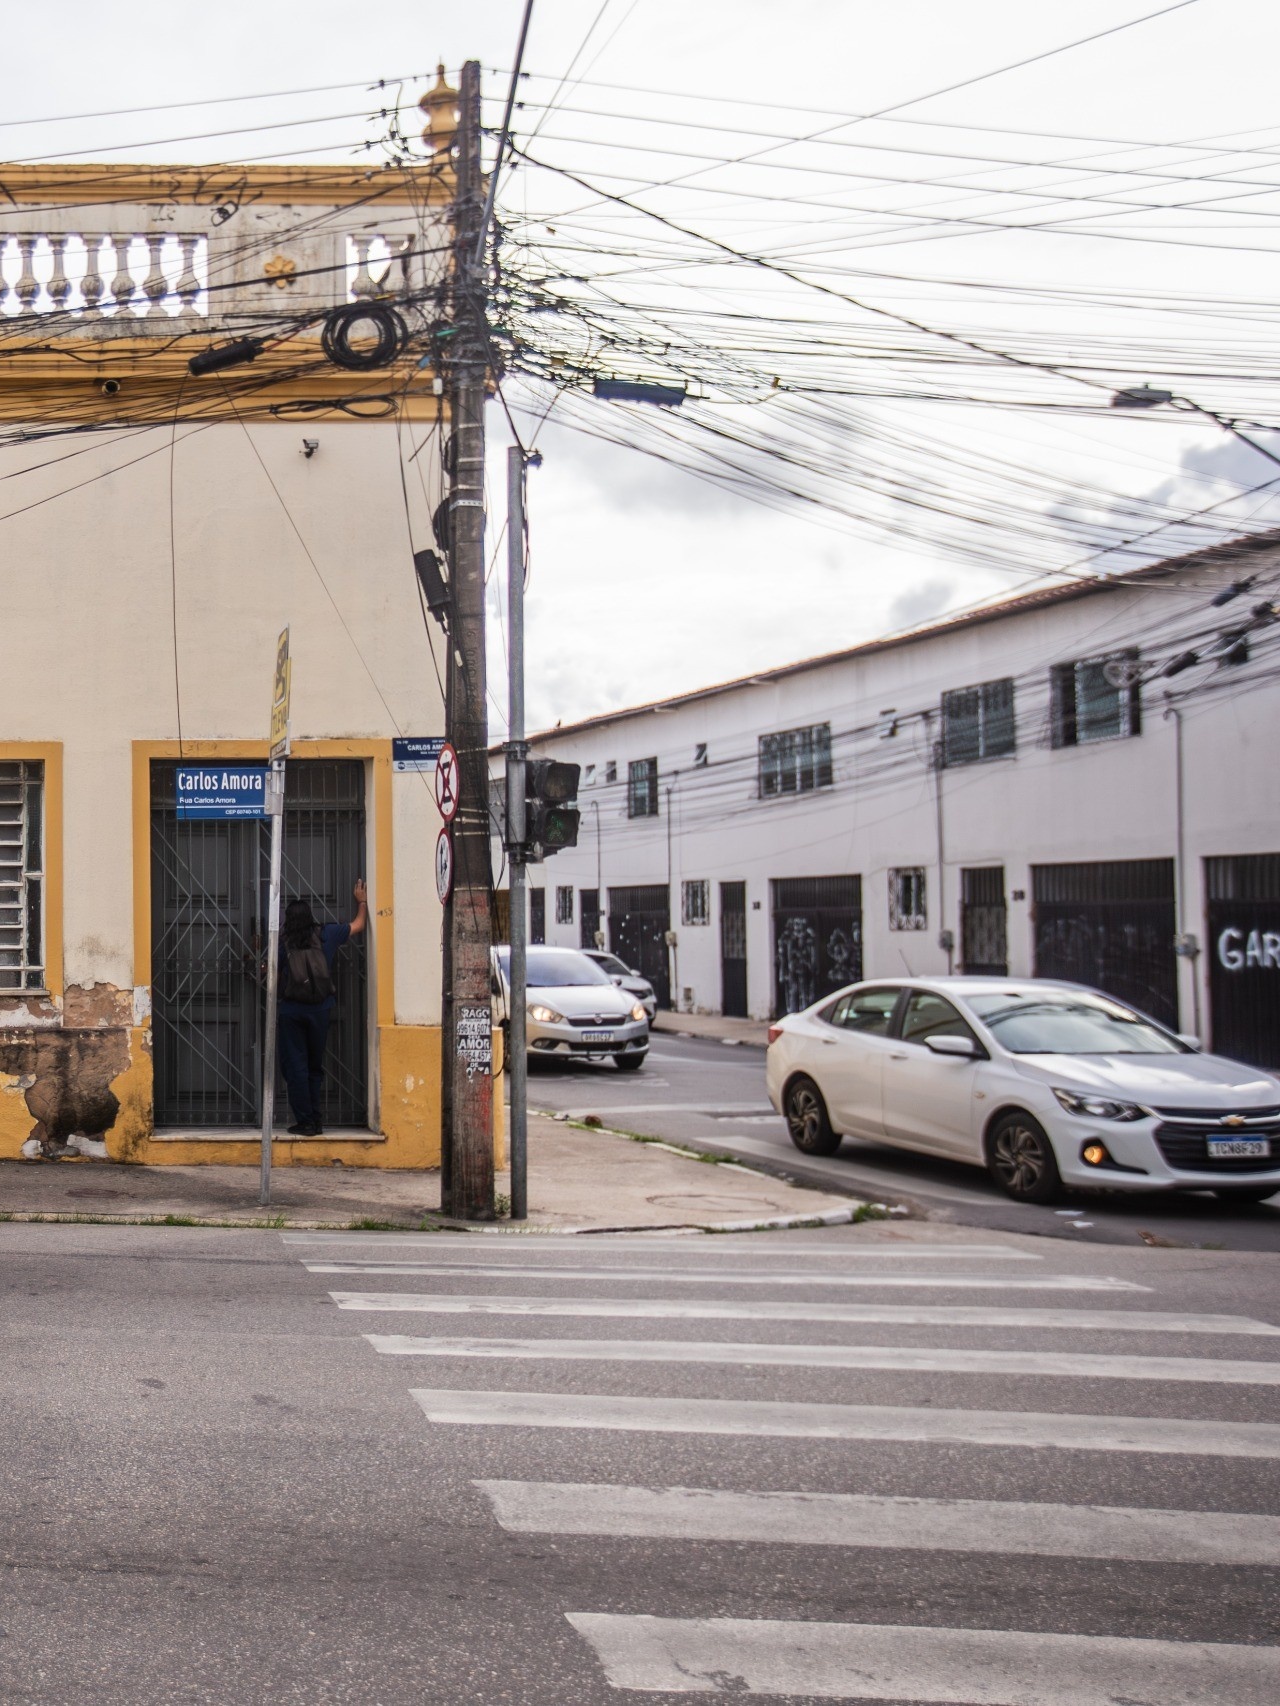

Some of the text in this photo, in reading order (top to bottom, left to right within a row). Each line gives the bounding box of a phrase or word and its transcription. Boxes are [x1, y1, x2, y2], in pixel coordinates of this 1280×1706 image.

[178, 771, 262, 790] Carlos Amora
[459, 1038, 490, 1050] AMOR
